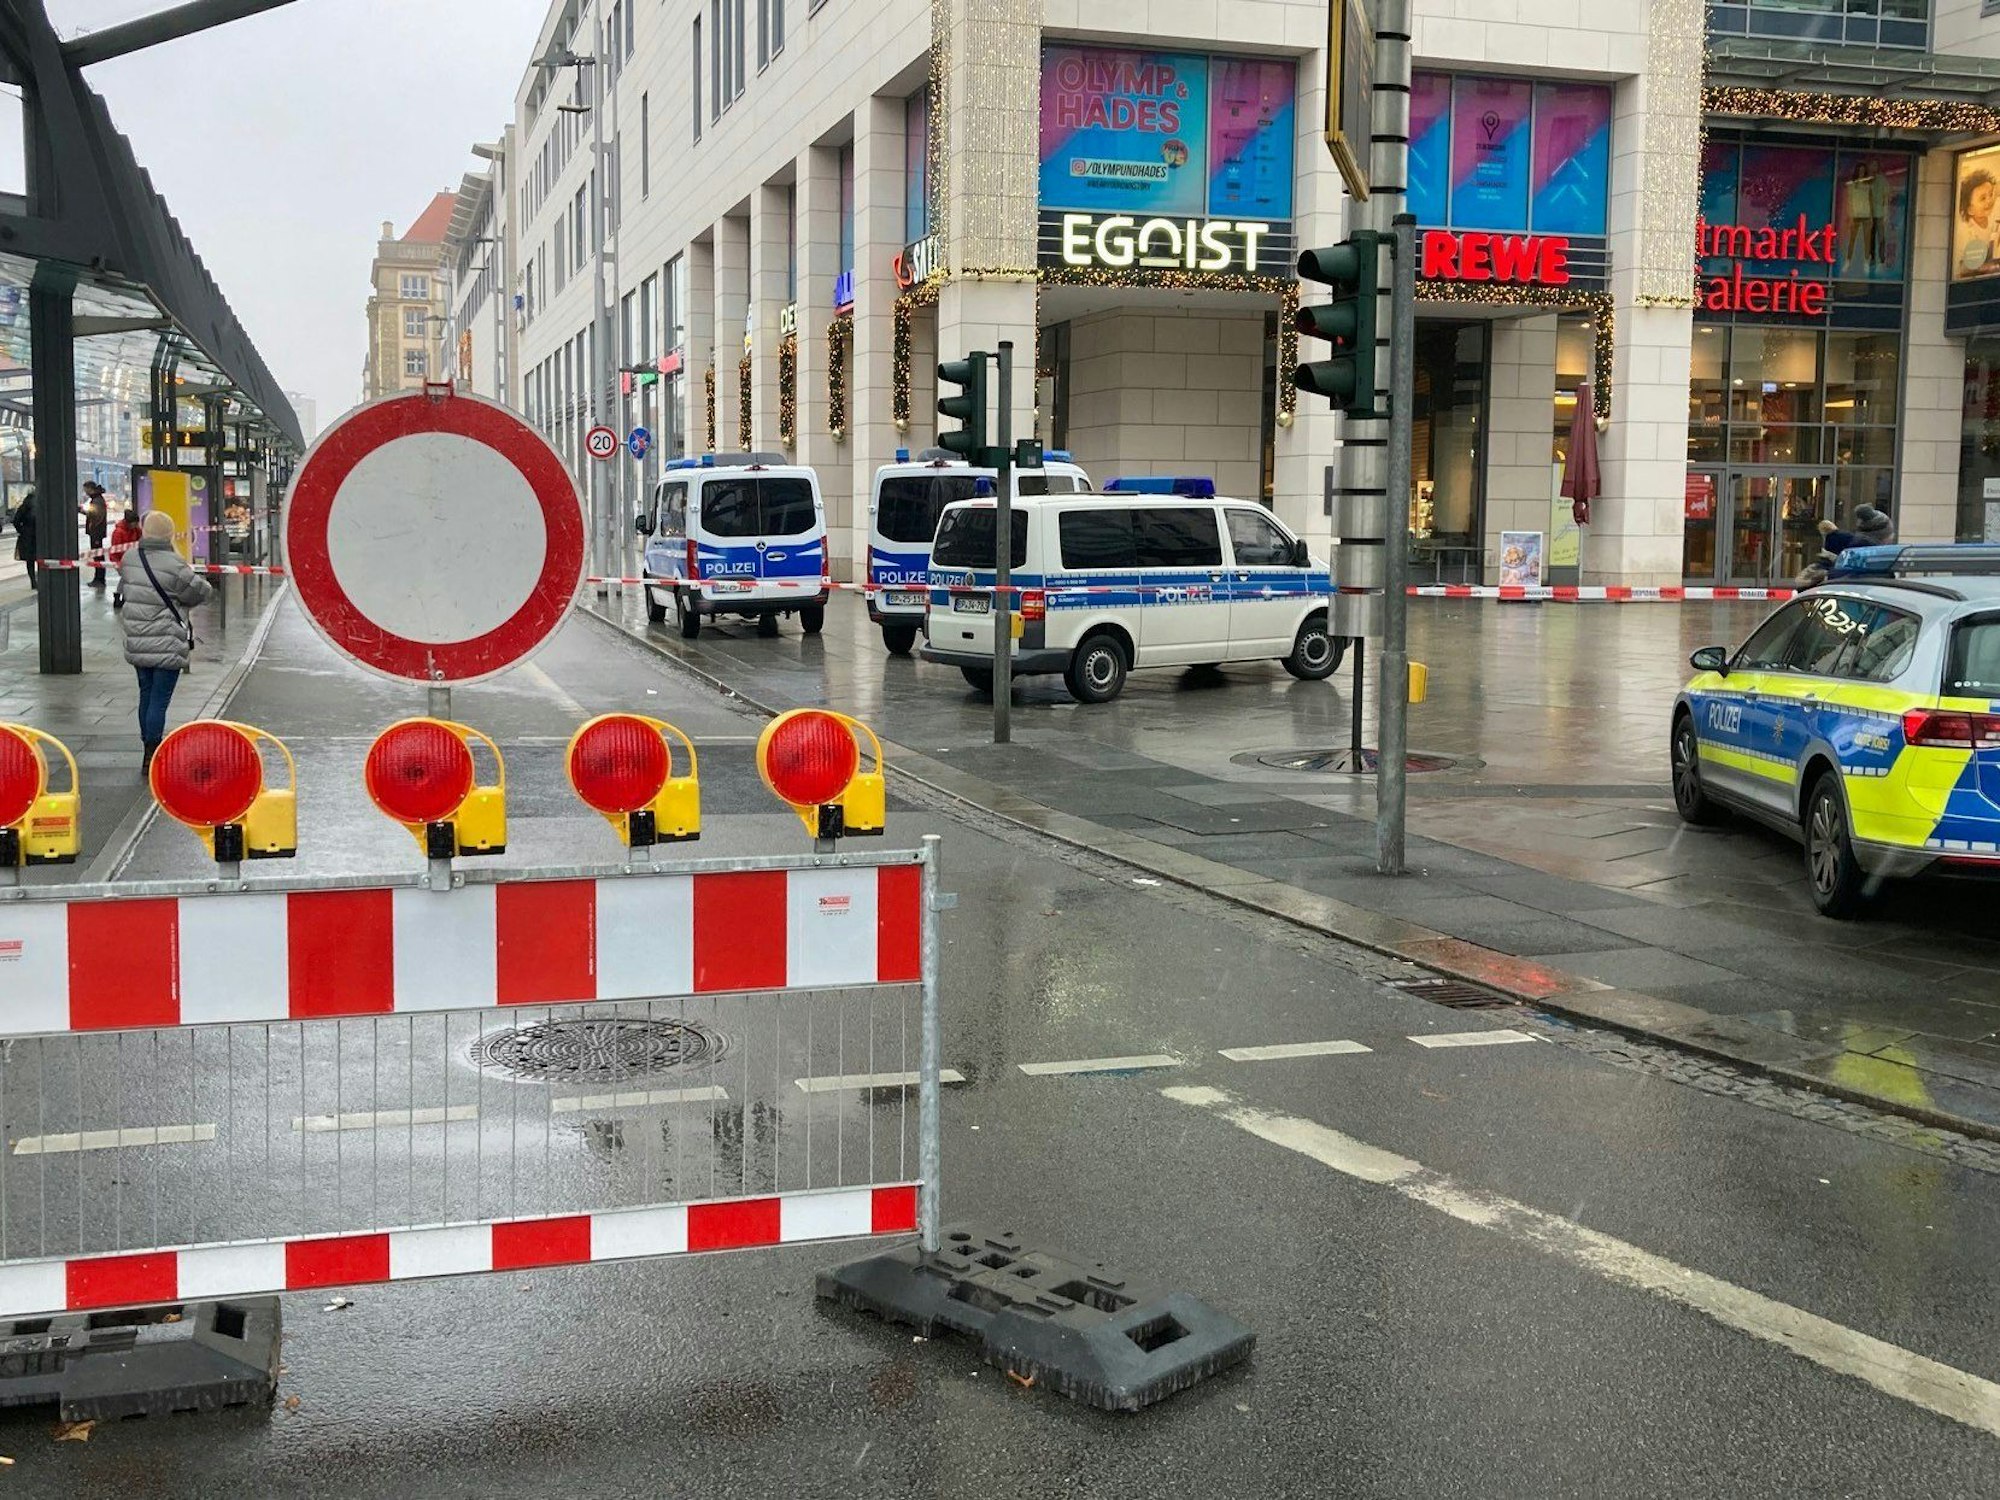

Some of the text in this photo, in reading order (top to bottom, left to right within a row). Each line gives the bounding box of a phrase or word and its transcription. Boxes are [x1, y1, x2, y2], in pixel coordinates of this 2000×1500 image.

[1057, 57, 1188, 99] OLYMP &
[1056, 93, 1180, 134] HADES
[1062, 212, 1270, 272] EGOIST
[1422, 231, 1570, 285] REWE
[1694, 262, 1826, 315] alerie
[593, 435, 611, 450] 20
[705, 562, 756, 574] POLIZEI
[879, 571, 926, 584] POLIZE
[930, 573, 964, 588] POLIZEI
[1156, 585, 1213, 604] POLIZEI
[1708, 702, 1743, 733] POLIZEI
